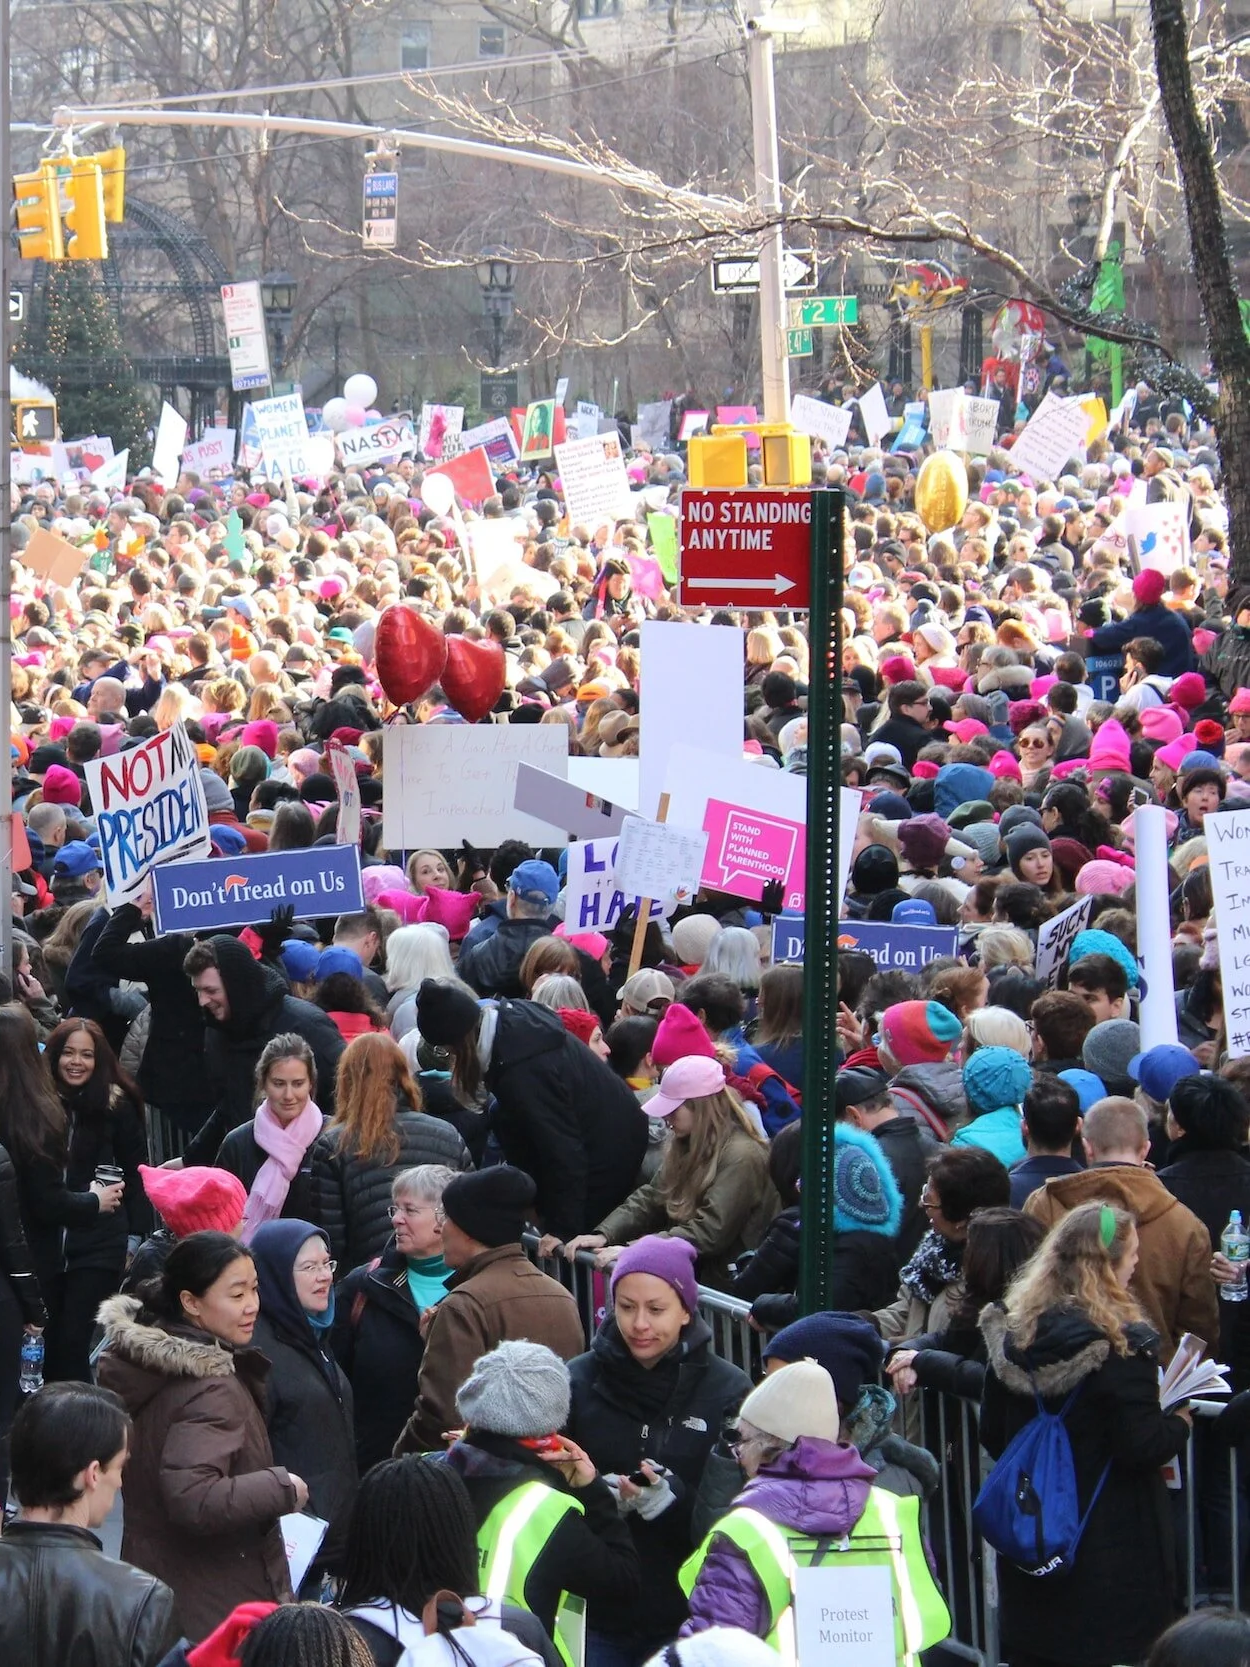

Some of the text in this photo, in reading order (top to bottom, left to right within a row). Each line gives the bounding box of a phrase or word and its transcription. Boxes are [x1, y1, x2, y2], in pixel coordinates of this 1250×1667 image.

[812, 301, 825, 321] 2
[256, 399, 298, 414] WOMEN
[259, 420, 302, 439] PLANET
[342, 426, 404, 455] NASTY
[688, 501, 812, 524] NO STANDING
[688, 529, 773, 551] ANYTIME
[1101, 675, 1116, 700] P
[100, 731, 170, 811] NOT
[422, 790, 507, 817] Impeached
[730, 833, 753, 845] WITH
[732, 822, 761, 836] STAND
[728, 843, 769, 860] PLANNED
[726, 853, 785, 876] PARENTHOOD
[172, 870, 346, 910] Don't Tread on Us
[1045, 899, 1091, 950] SUCK
[894, 951, 917, 966] on
[821, 1607, 869, 1622] Protest
[819, 1629, 873, 1643] Monitor
